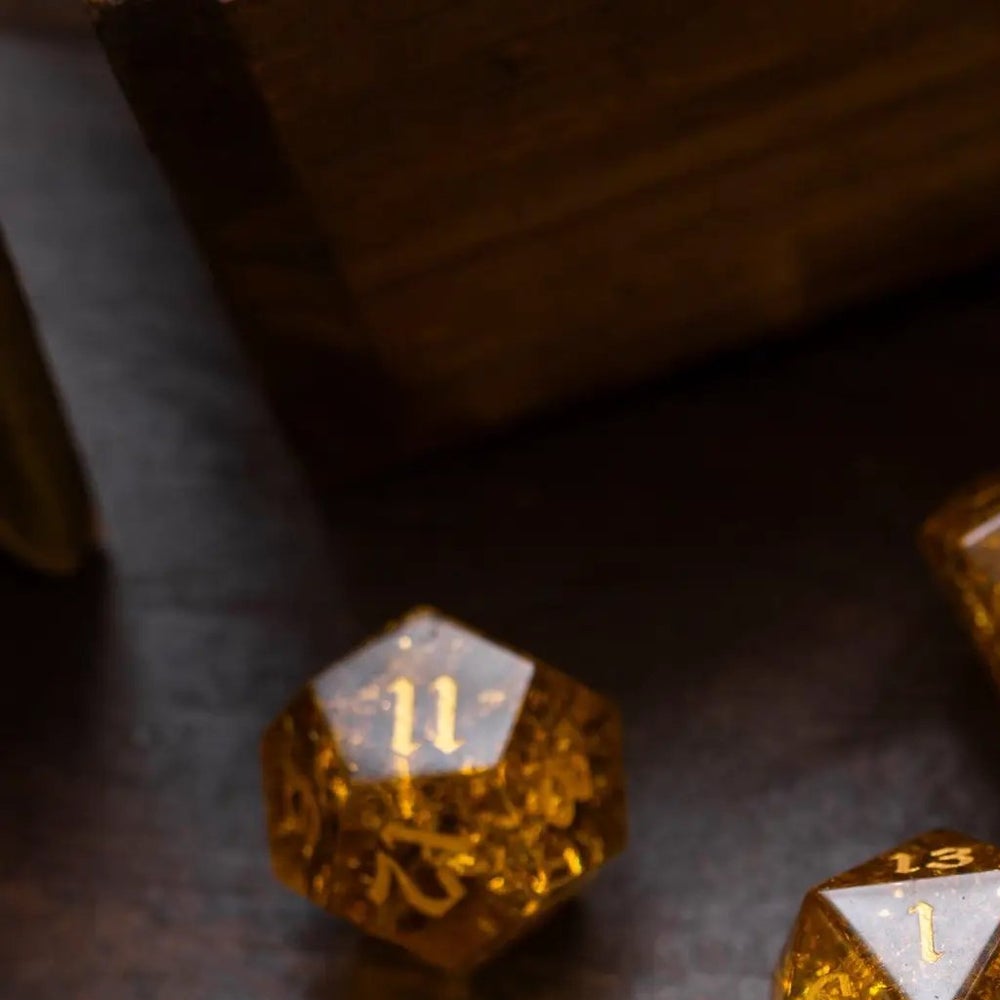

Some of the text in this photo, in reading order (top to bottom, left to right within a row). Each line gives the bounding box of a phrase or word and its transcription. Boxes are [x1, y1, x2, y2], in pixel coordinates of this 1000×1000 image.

[387, 675, 465, 756] 11
[889, 846, 975, 874] 13
[907, 900, 945, 965] 1
